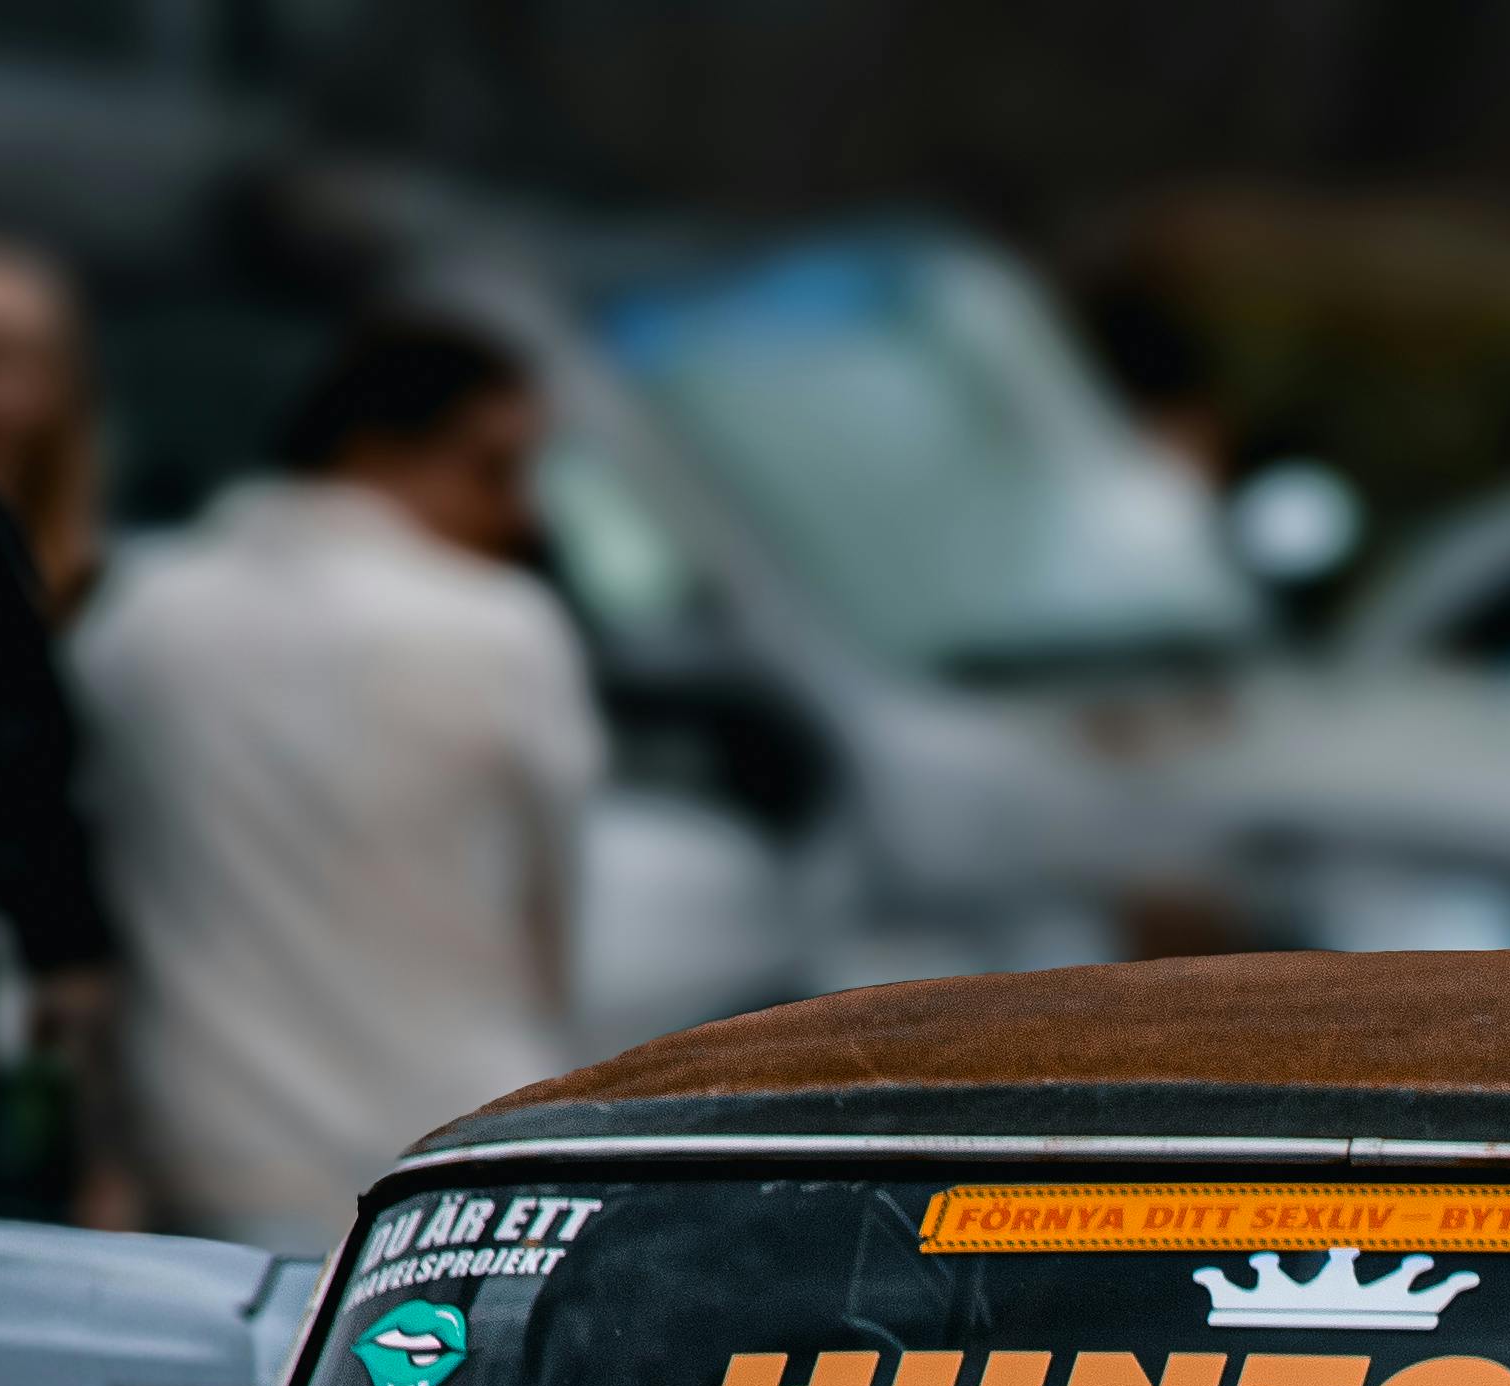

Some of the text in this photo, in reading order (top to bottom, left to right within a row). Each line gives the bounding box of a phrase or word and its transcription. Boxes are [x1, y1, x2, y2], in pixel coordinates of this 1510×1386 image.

[360, 1194, 603, 1275] DU ÄR ETT
[955, 1200, 1125, 1232] FÖRNYA
[1143, 1206, 1239, 1231] DITT
[1250, 1206, 1395, 1232] SEXLIV
